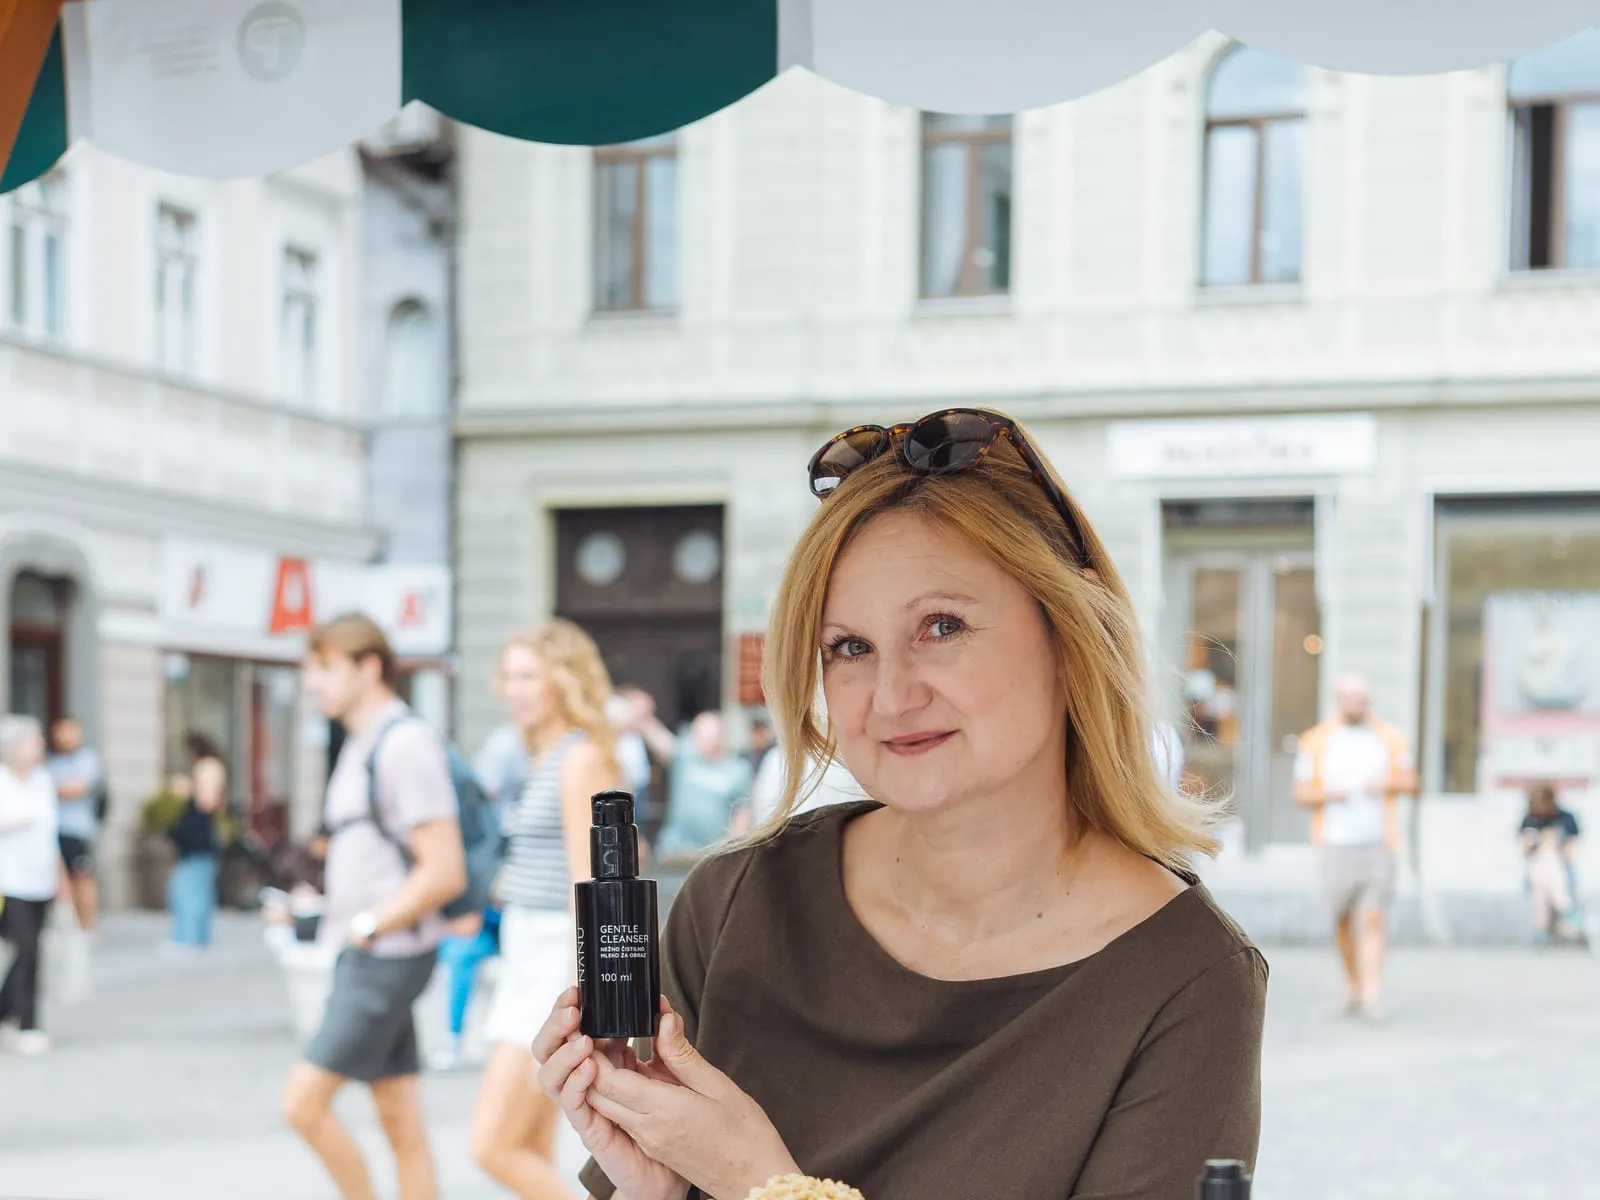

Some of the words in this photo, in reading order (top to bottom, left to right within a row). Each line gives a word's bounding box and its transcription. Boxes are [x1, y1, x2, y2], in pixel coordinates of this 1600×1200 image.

[600, 924, 639, 934] GENTLE
[600, 934, 649, 944] CLEANSER
[577, 927, 585, 982] NANU
[601, 973, 617, 982] 100
[620, 972, 632, 982] ml
